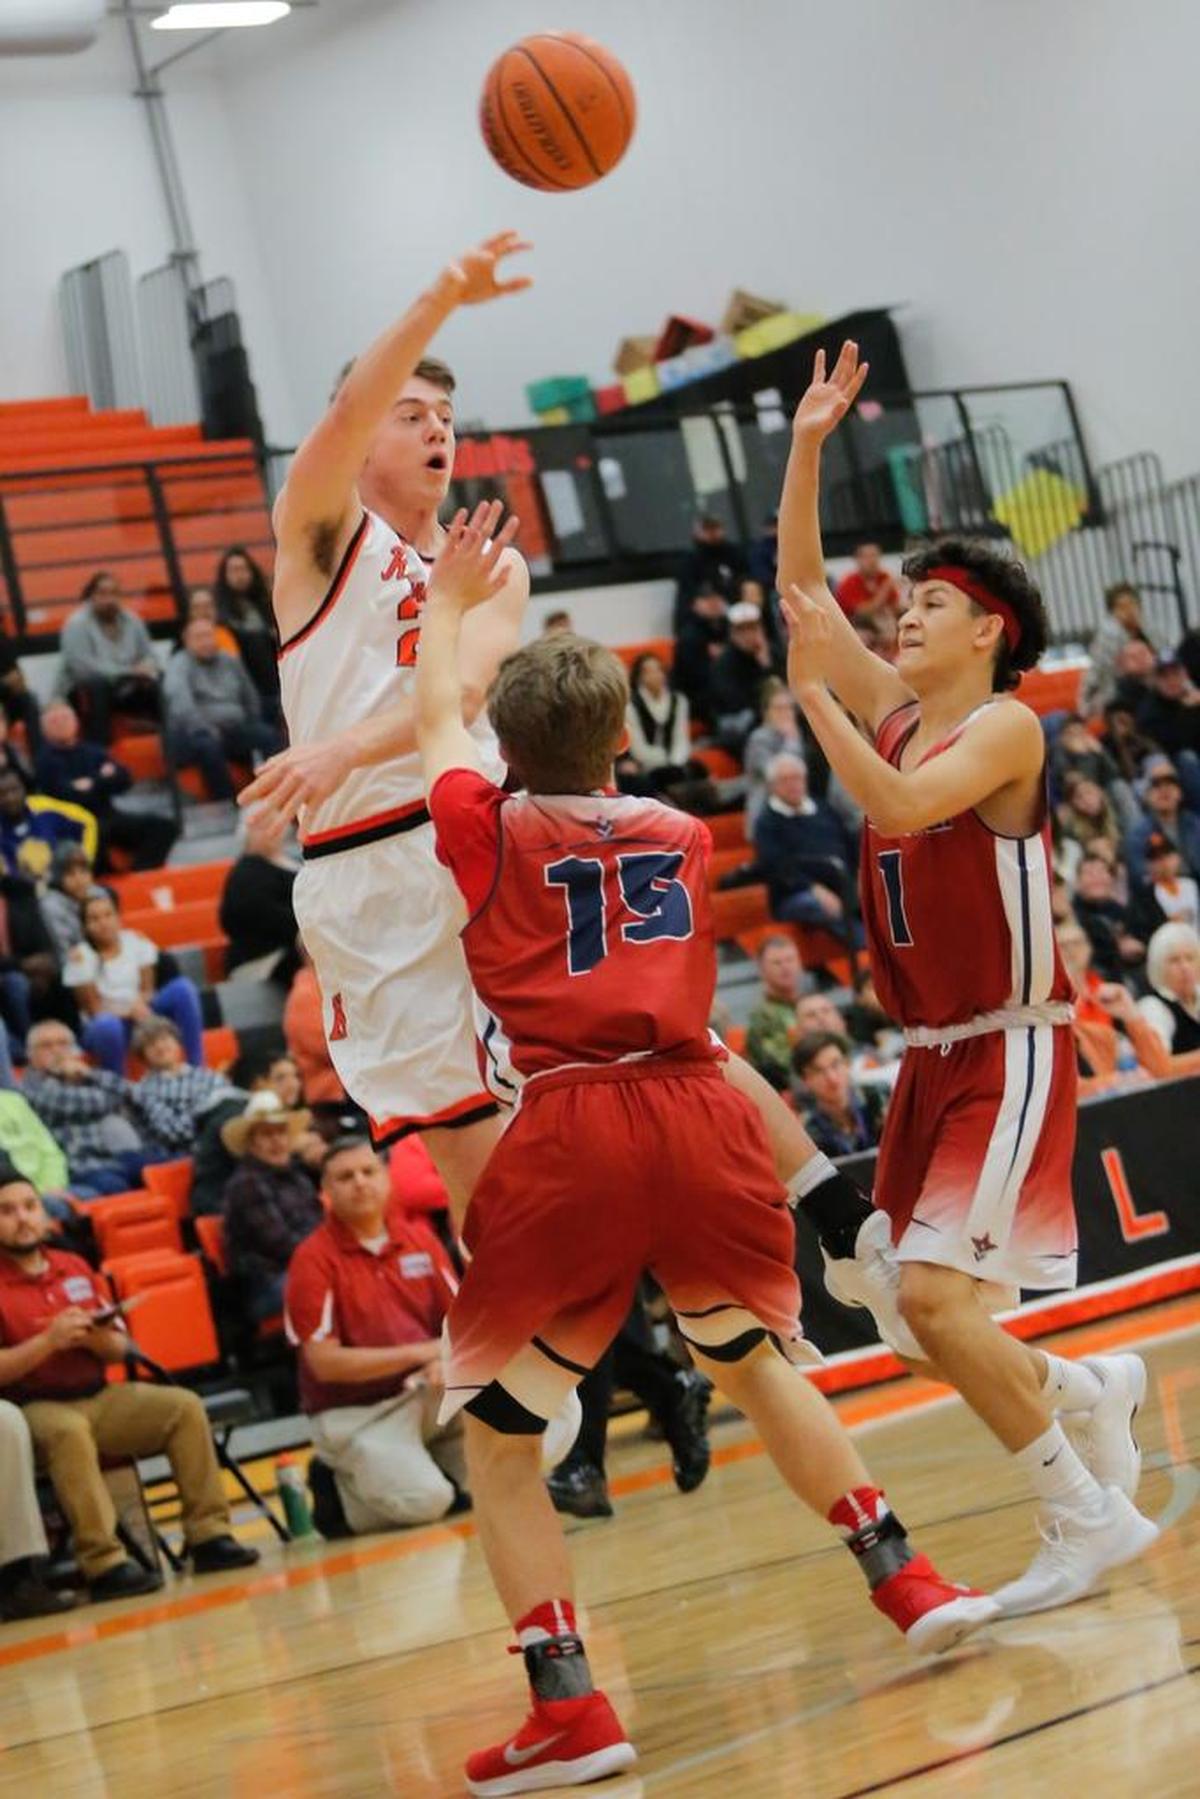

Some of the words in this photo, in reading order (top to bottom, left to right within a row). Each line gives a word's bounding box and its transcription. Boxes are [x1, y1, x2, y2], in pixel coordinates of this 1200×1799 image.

[544, 851, 694, 976] 15
[878, 849, 914, 947] 1
[1100, 1147, 1170, 1243] L
